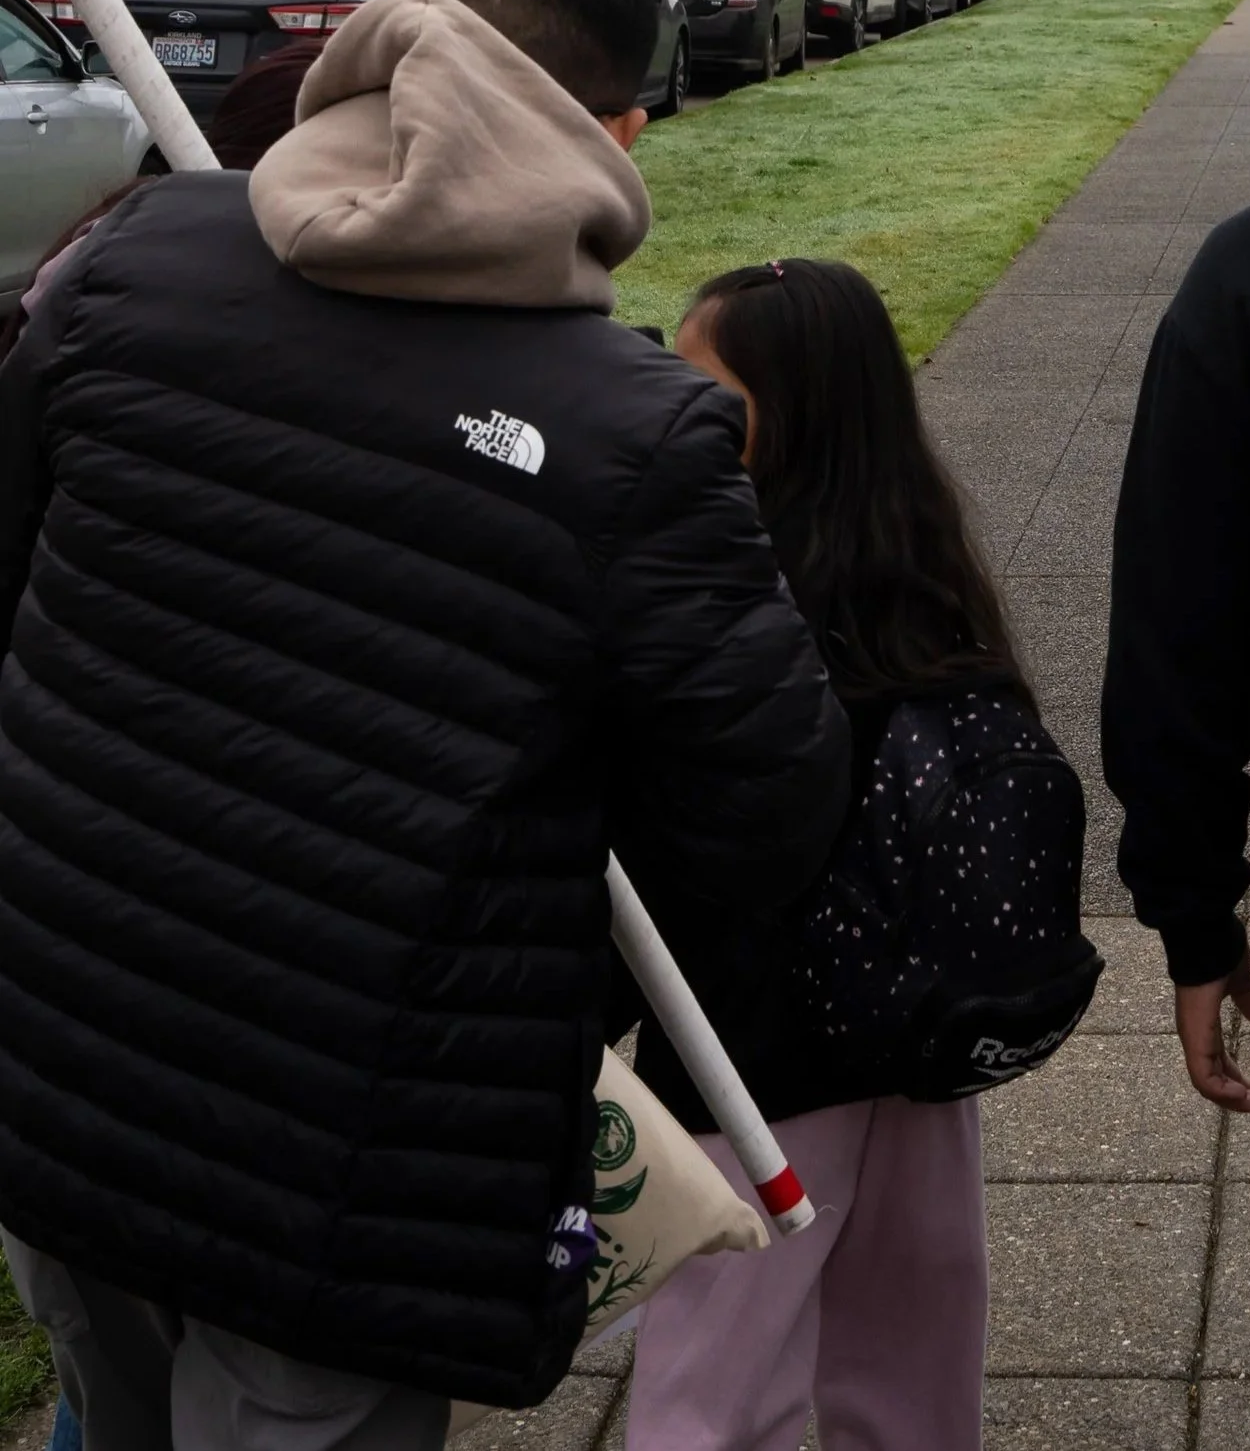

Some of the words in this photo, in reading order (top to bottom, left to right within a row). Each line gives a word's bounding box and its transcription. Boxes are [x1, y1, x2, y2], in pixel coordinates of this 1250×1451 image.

[155, 43, 212, 61] BRG8755
[454, 413, 519, 449] NORTH
[490, 409, 524, 433] THE
[465, 433, 511, 462] FACE
